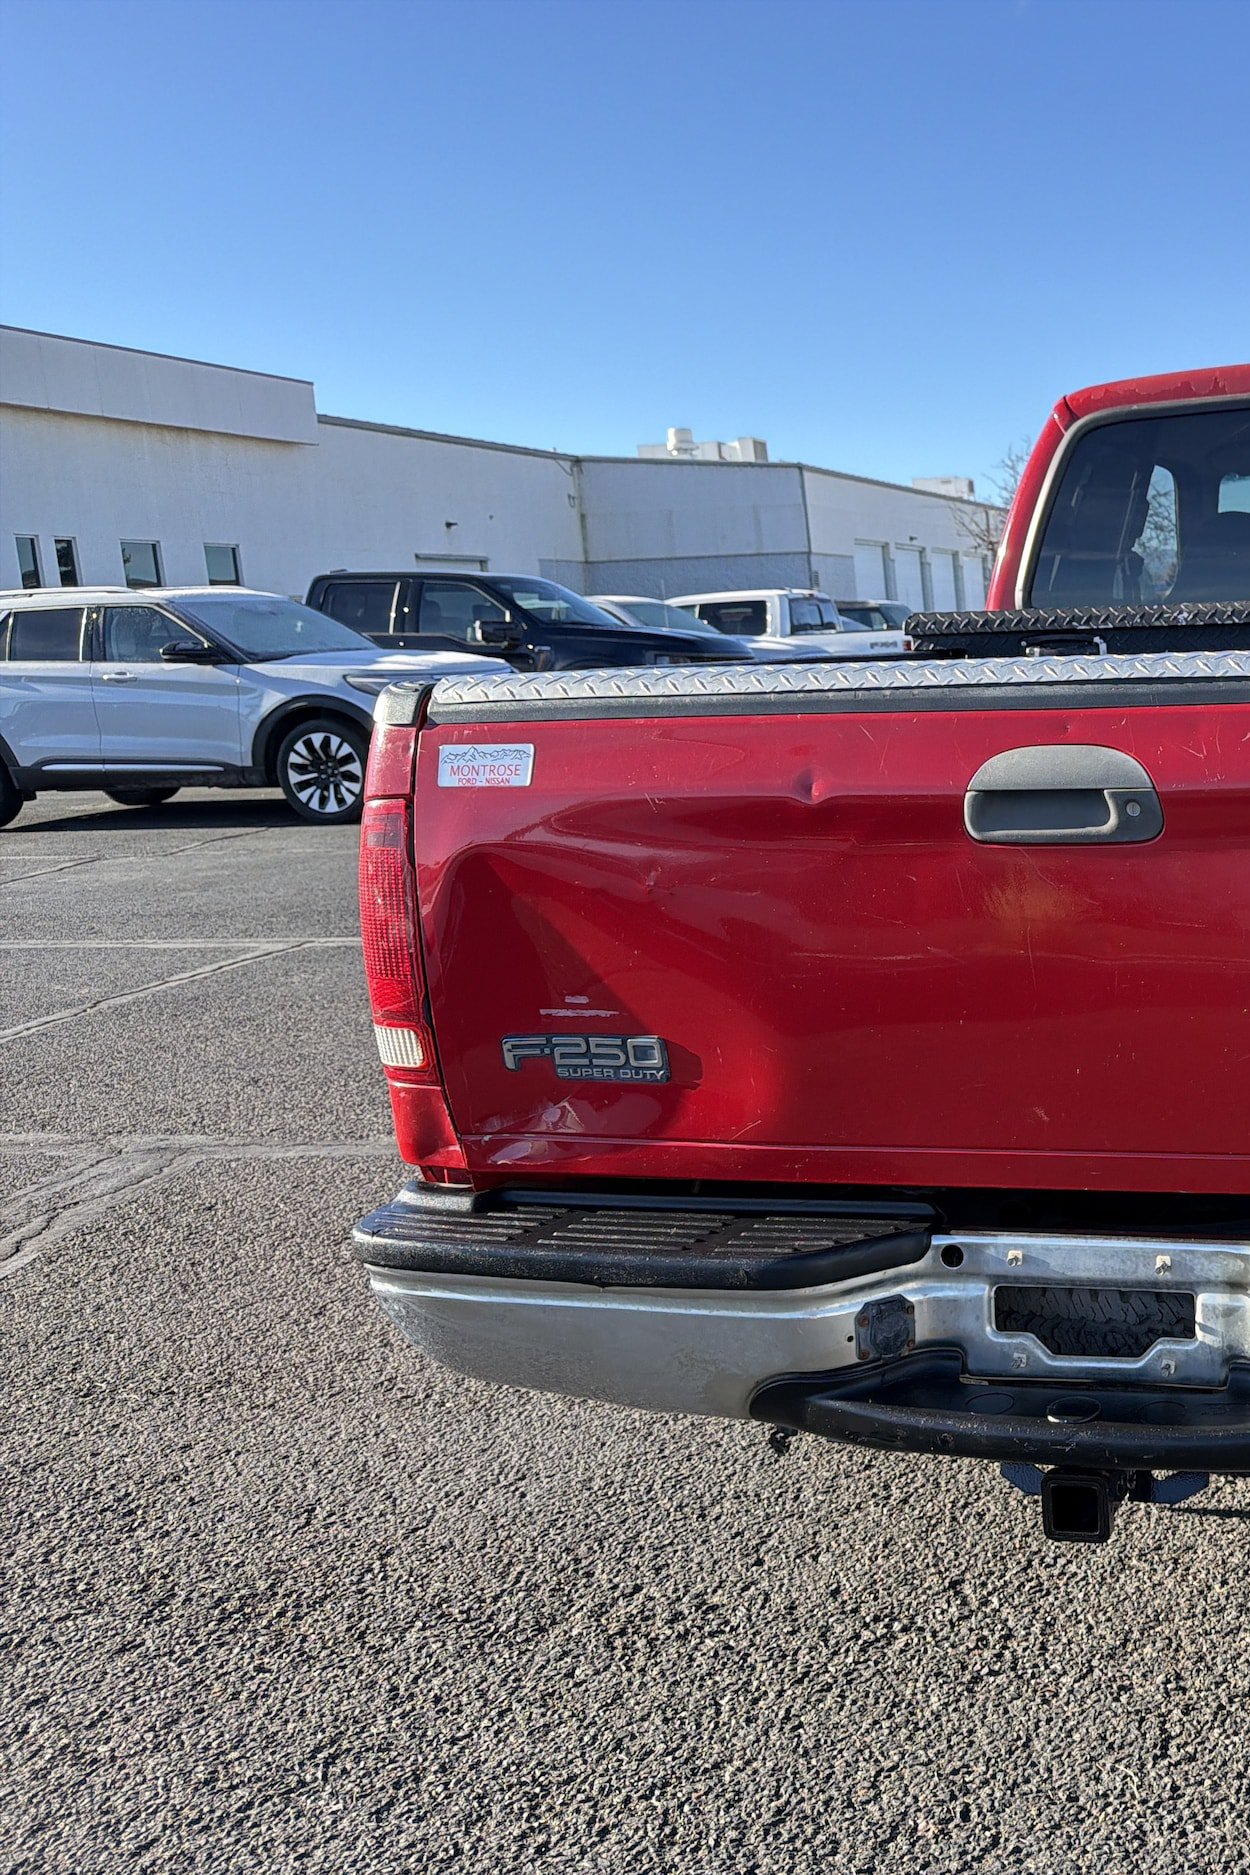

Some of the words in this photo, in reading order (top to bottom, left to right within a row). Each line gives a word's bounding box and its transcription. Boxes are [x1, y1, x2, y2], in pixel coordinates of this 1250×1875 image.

[449, 764, 522, 777] MONTROSE
[457, 777, 477, 786] FORD
[485, 777, 511, 785] NISSAN
[556, 1067, 615, 1079] SUPER
[619, 1069, 665, 1081] DUTY
